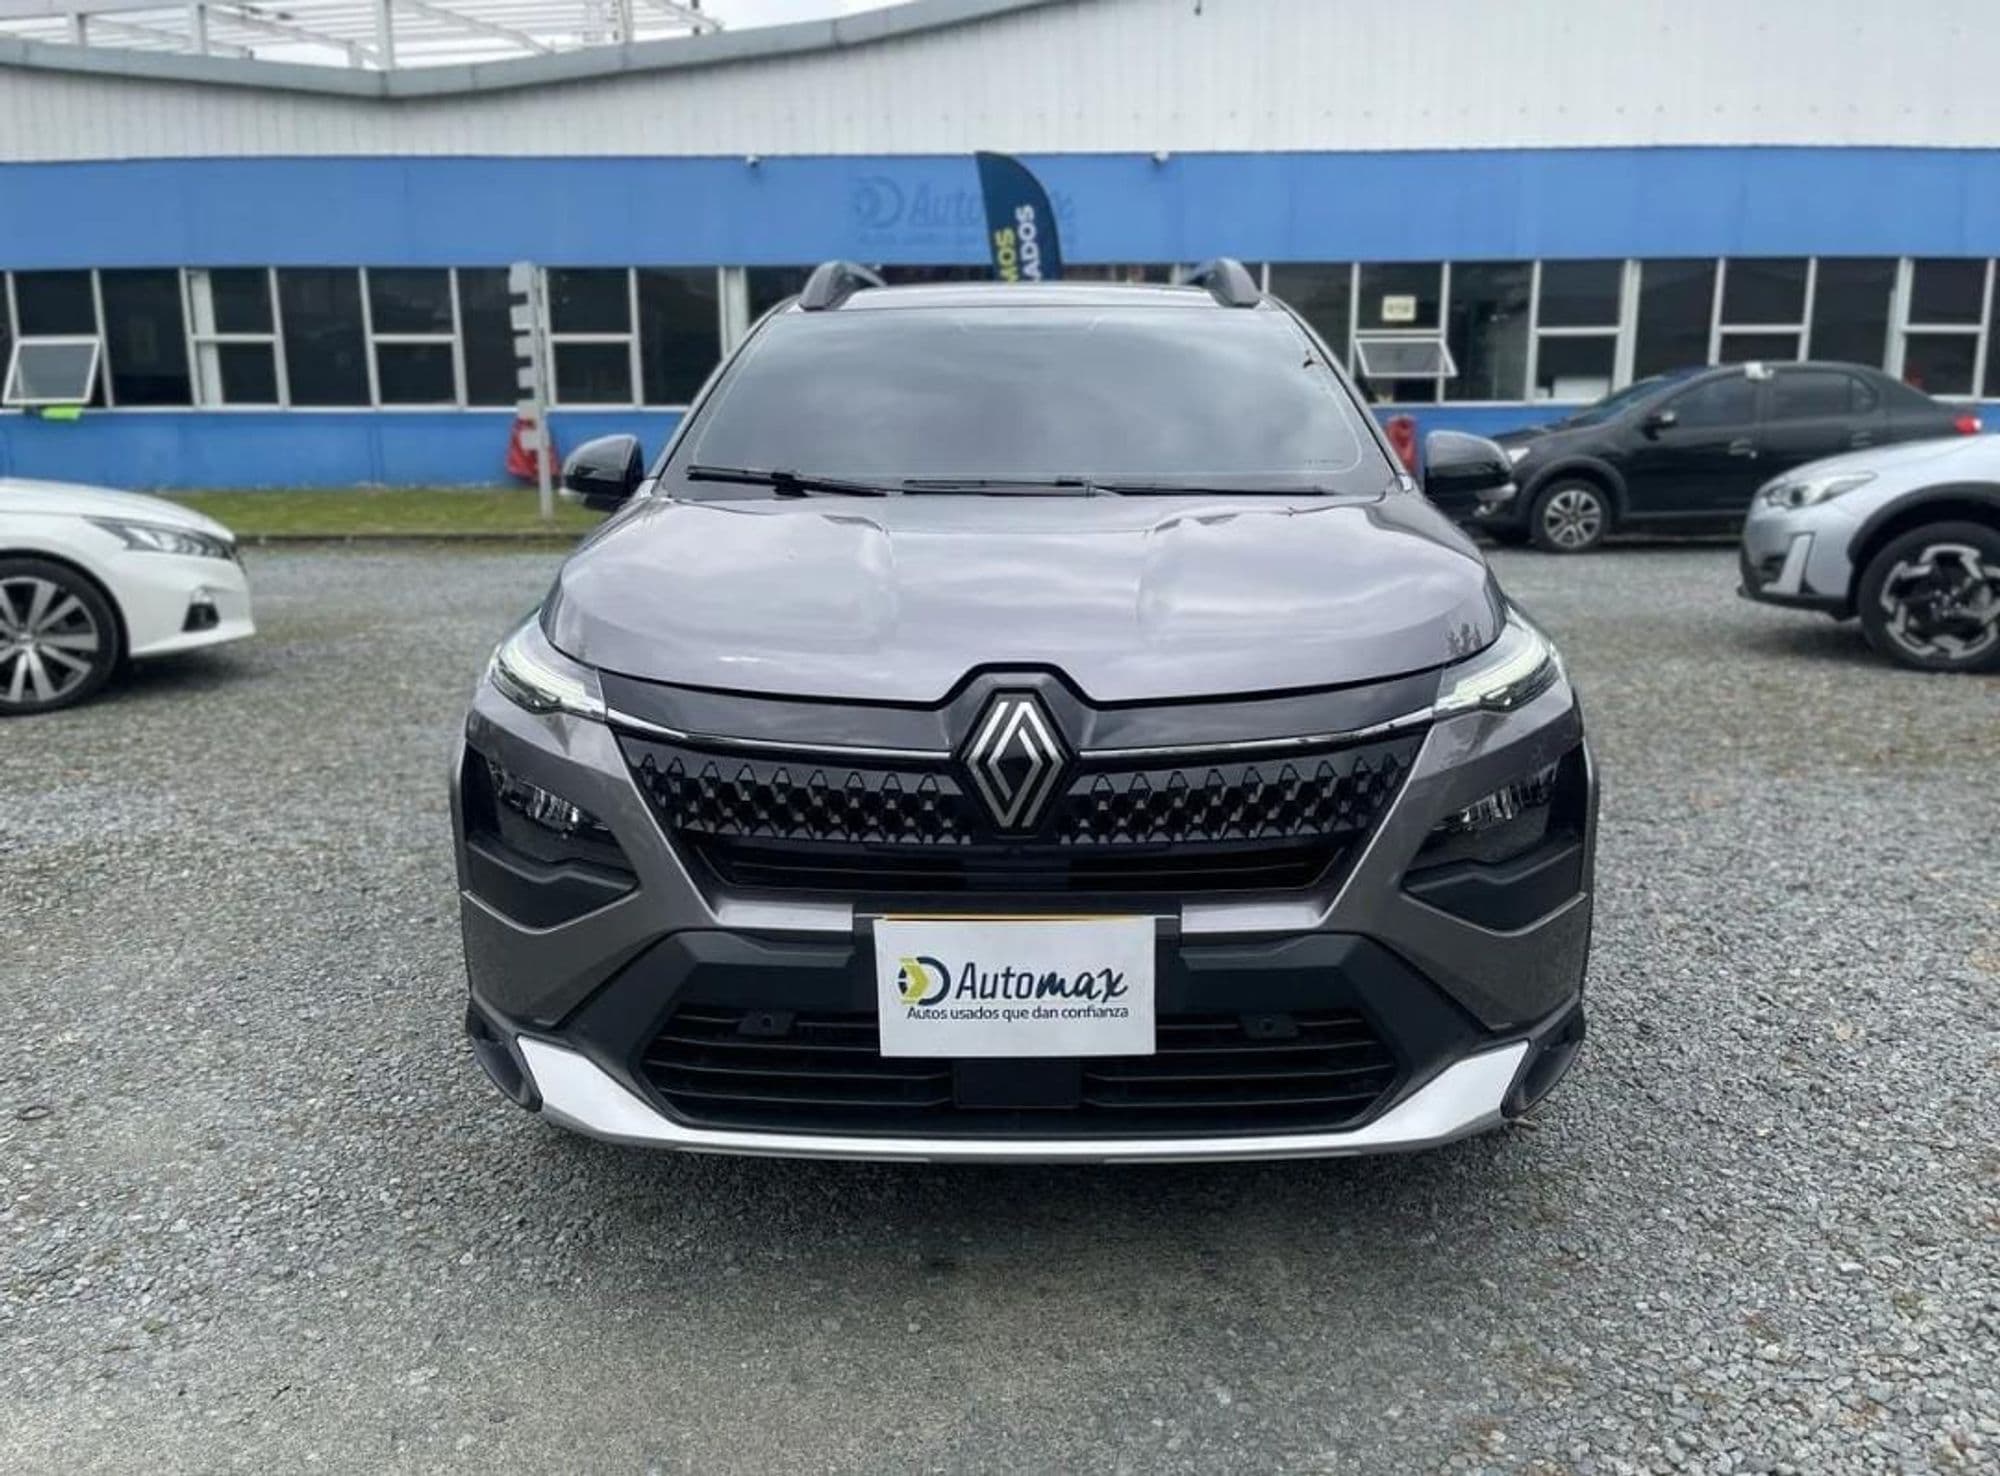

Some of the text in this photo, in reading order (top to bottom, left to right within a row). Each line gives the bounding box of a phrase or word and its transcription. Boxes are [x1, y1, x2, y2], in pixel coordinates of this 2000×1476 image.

[955, 962, 1129, 1003] Automax
[907, 1005, 1129, 1023] Autos usados que dan confianza
